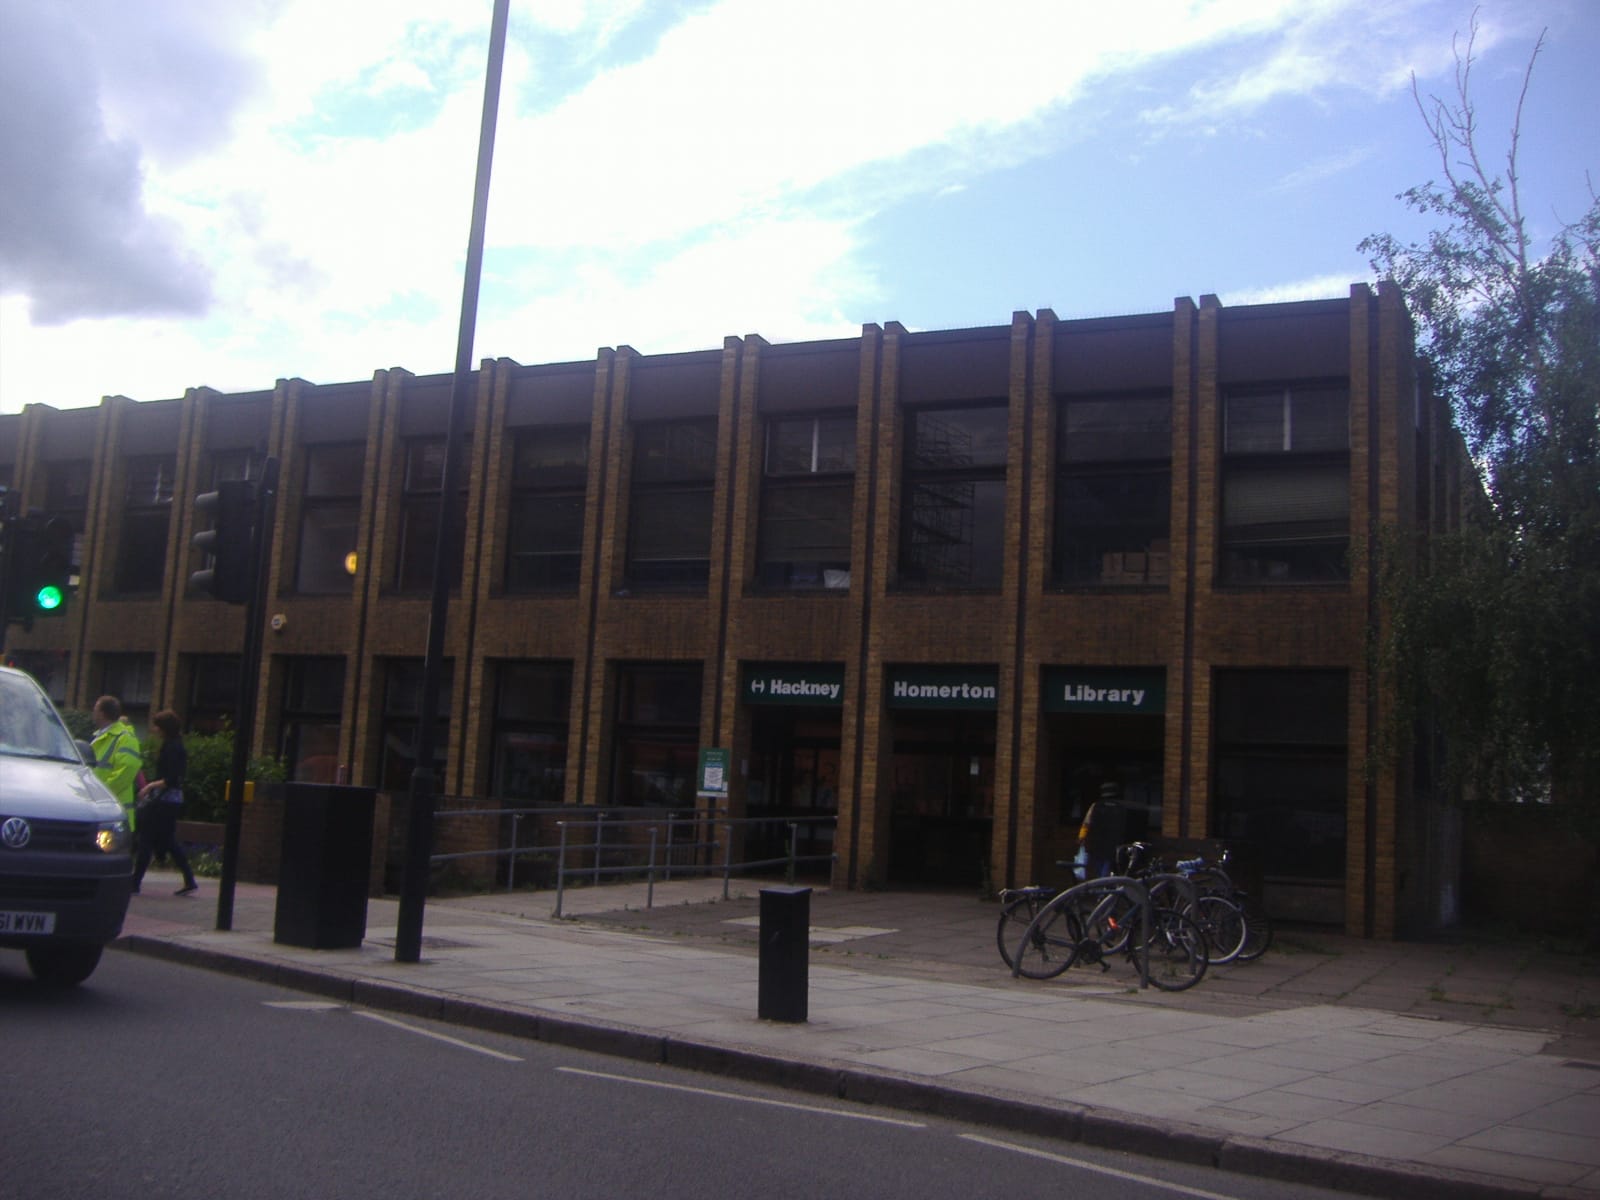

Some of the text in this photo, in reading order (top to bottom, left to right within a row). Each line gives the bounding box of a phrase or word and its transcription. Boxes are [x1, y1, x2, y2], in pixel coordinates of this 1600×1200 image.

[770, 680, 1145, 706] Hackney Homerton Library
